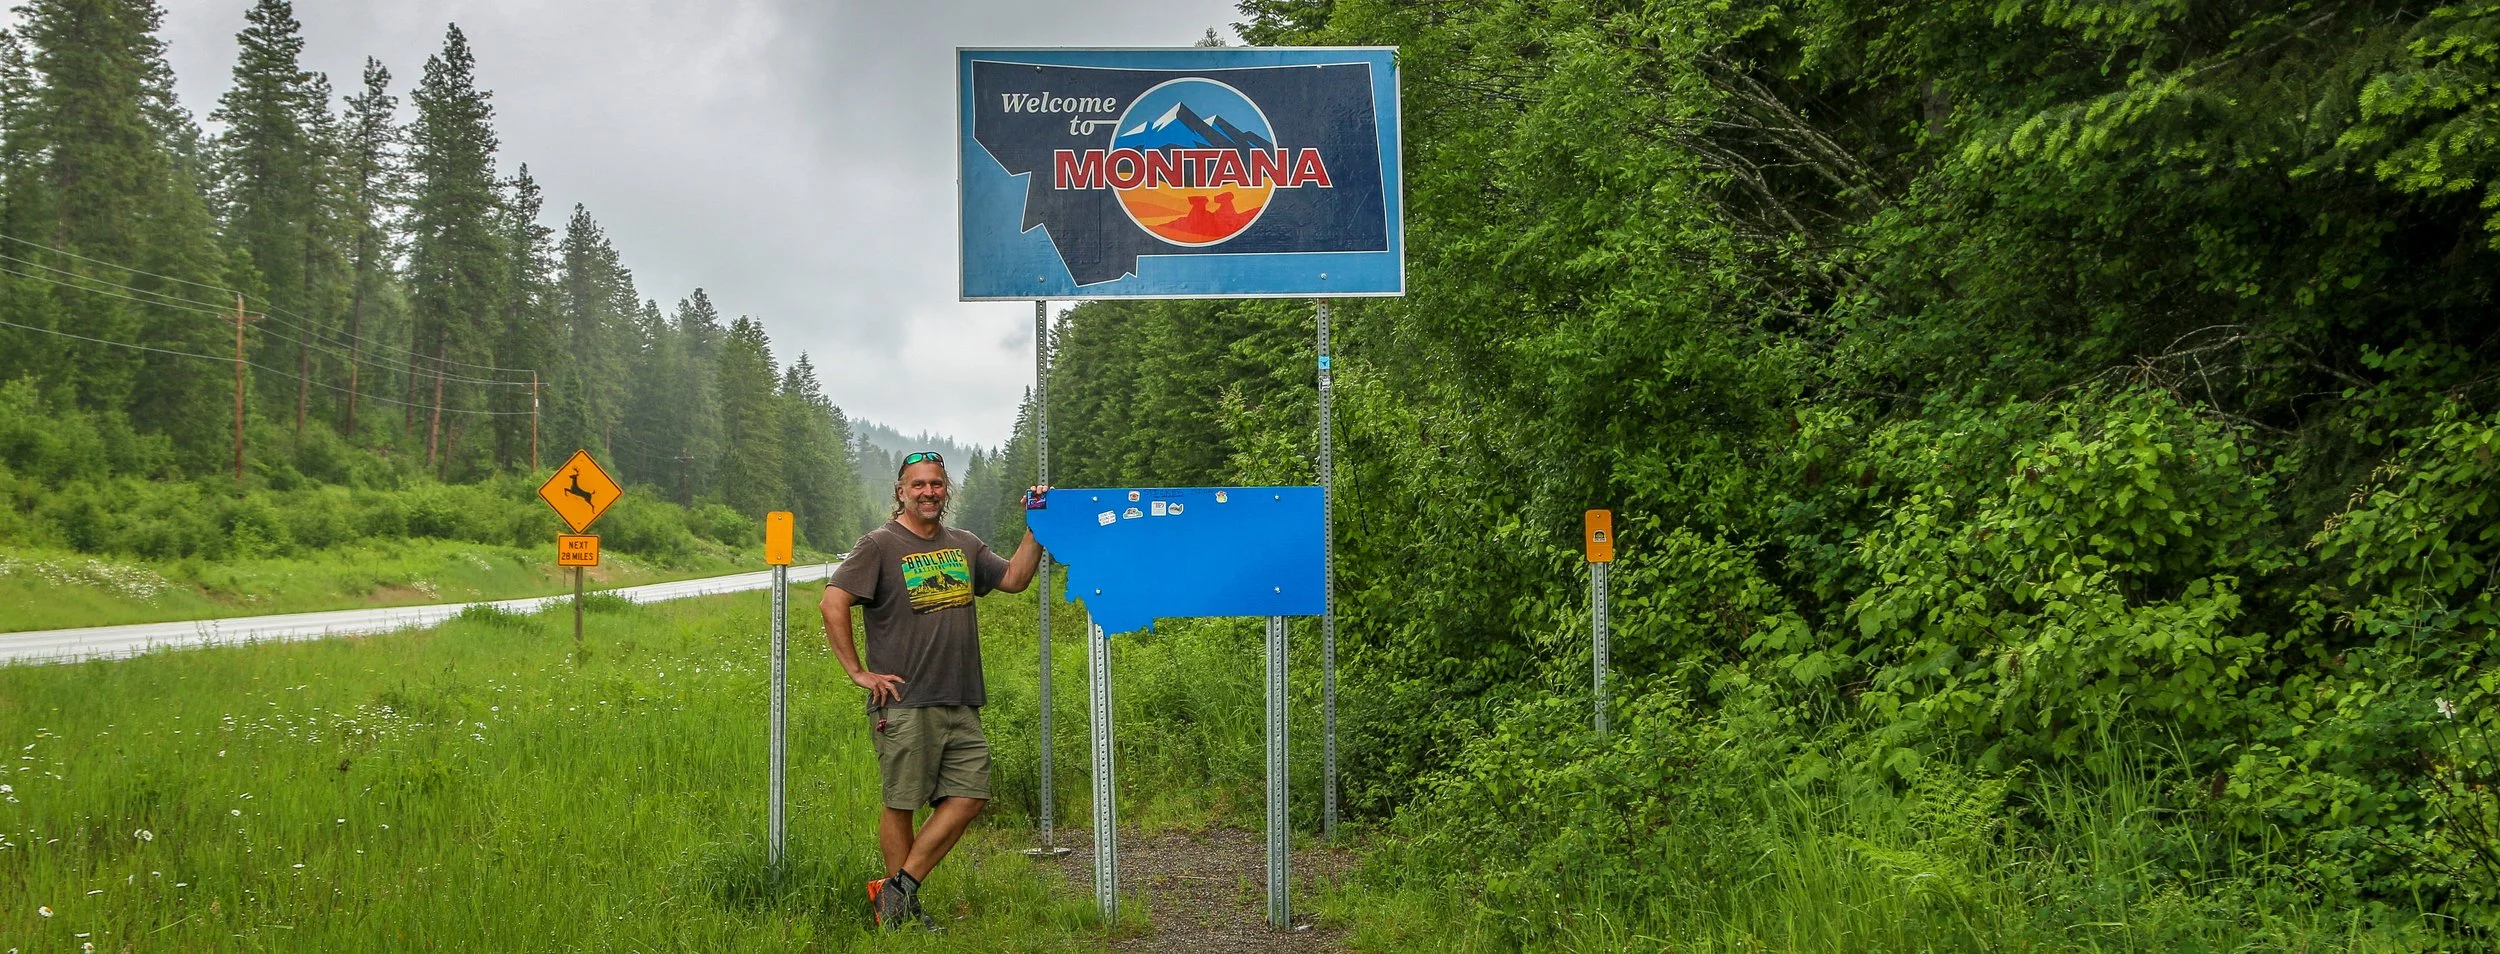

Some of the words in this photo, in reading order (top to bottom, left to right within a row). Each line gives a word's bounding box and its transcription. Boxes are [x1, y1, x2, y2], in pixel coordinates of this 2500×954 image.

[1001, 91, 1117, 114] Welcome
[1069, 113, 1095, 136] to
[1053, 147, 1333, 190] MONTANA
[568, 541, 588, 549] NEXT
[561, 552, 571, 560] 28
[572, 552, 593, 560] MILES
[907, 549, 963, 569] BADLANDS
